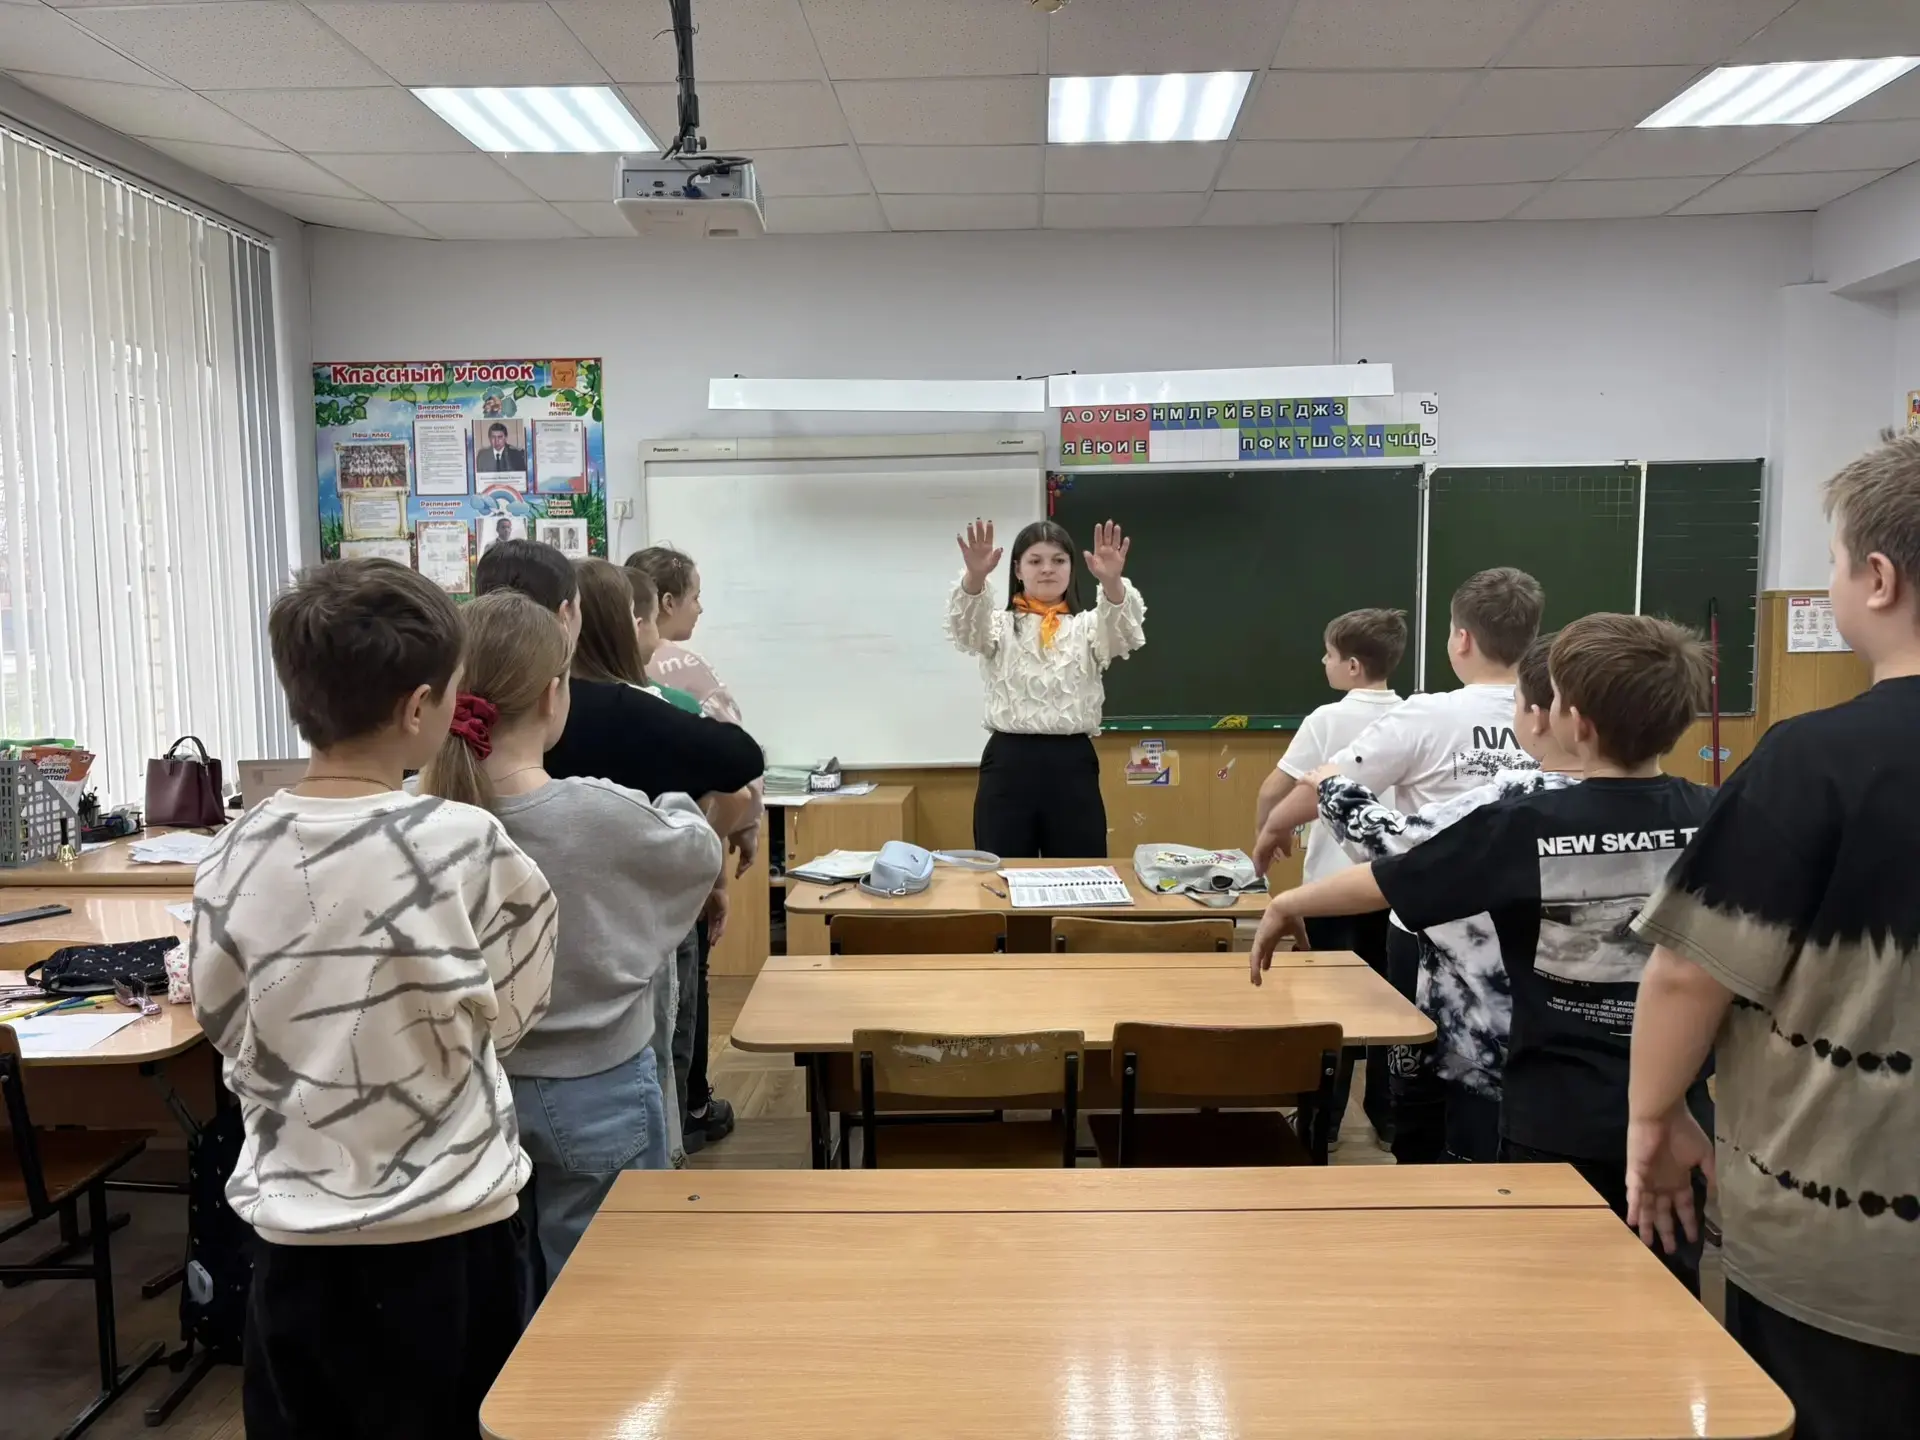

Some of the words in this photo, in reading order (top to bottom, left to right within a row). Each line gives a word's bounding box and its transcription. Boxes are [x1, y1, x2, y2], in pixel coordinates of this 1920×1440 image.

[331, 363, 444, 384] Классный
[455, 365, 533, 383] уголок
[1473, 725, 1521, 750] NA
[39, 767, 70, 775] ВЕТНОЙ
[1537, 834, 1596, 856] NEW
[1601, 829, 1675, 852] SKATE
[1679, 827, 1700, 846] T
